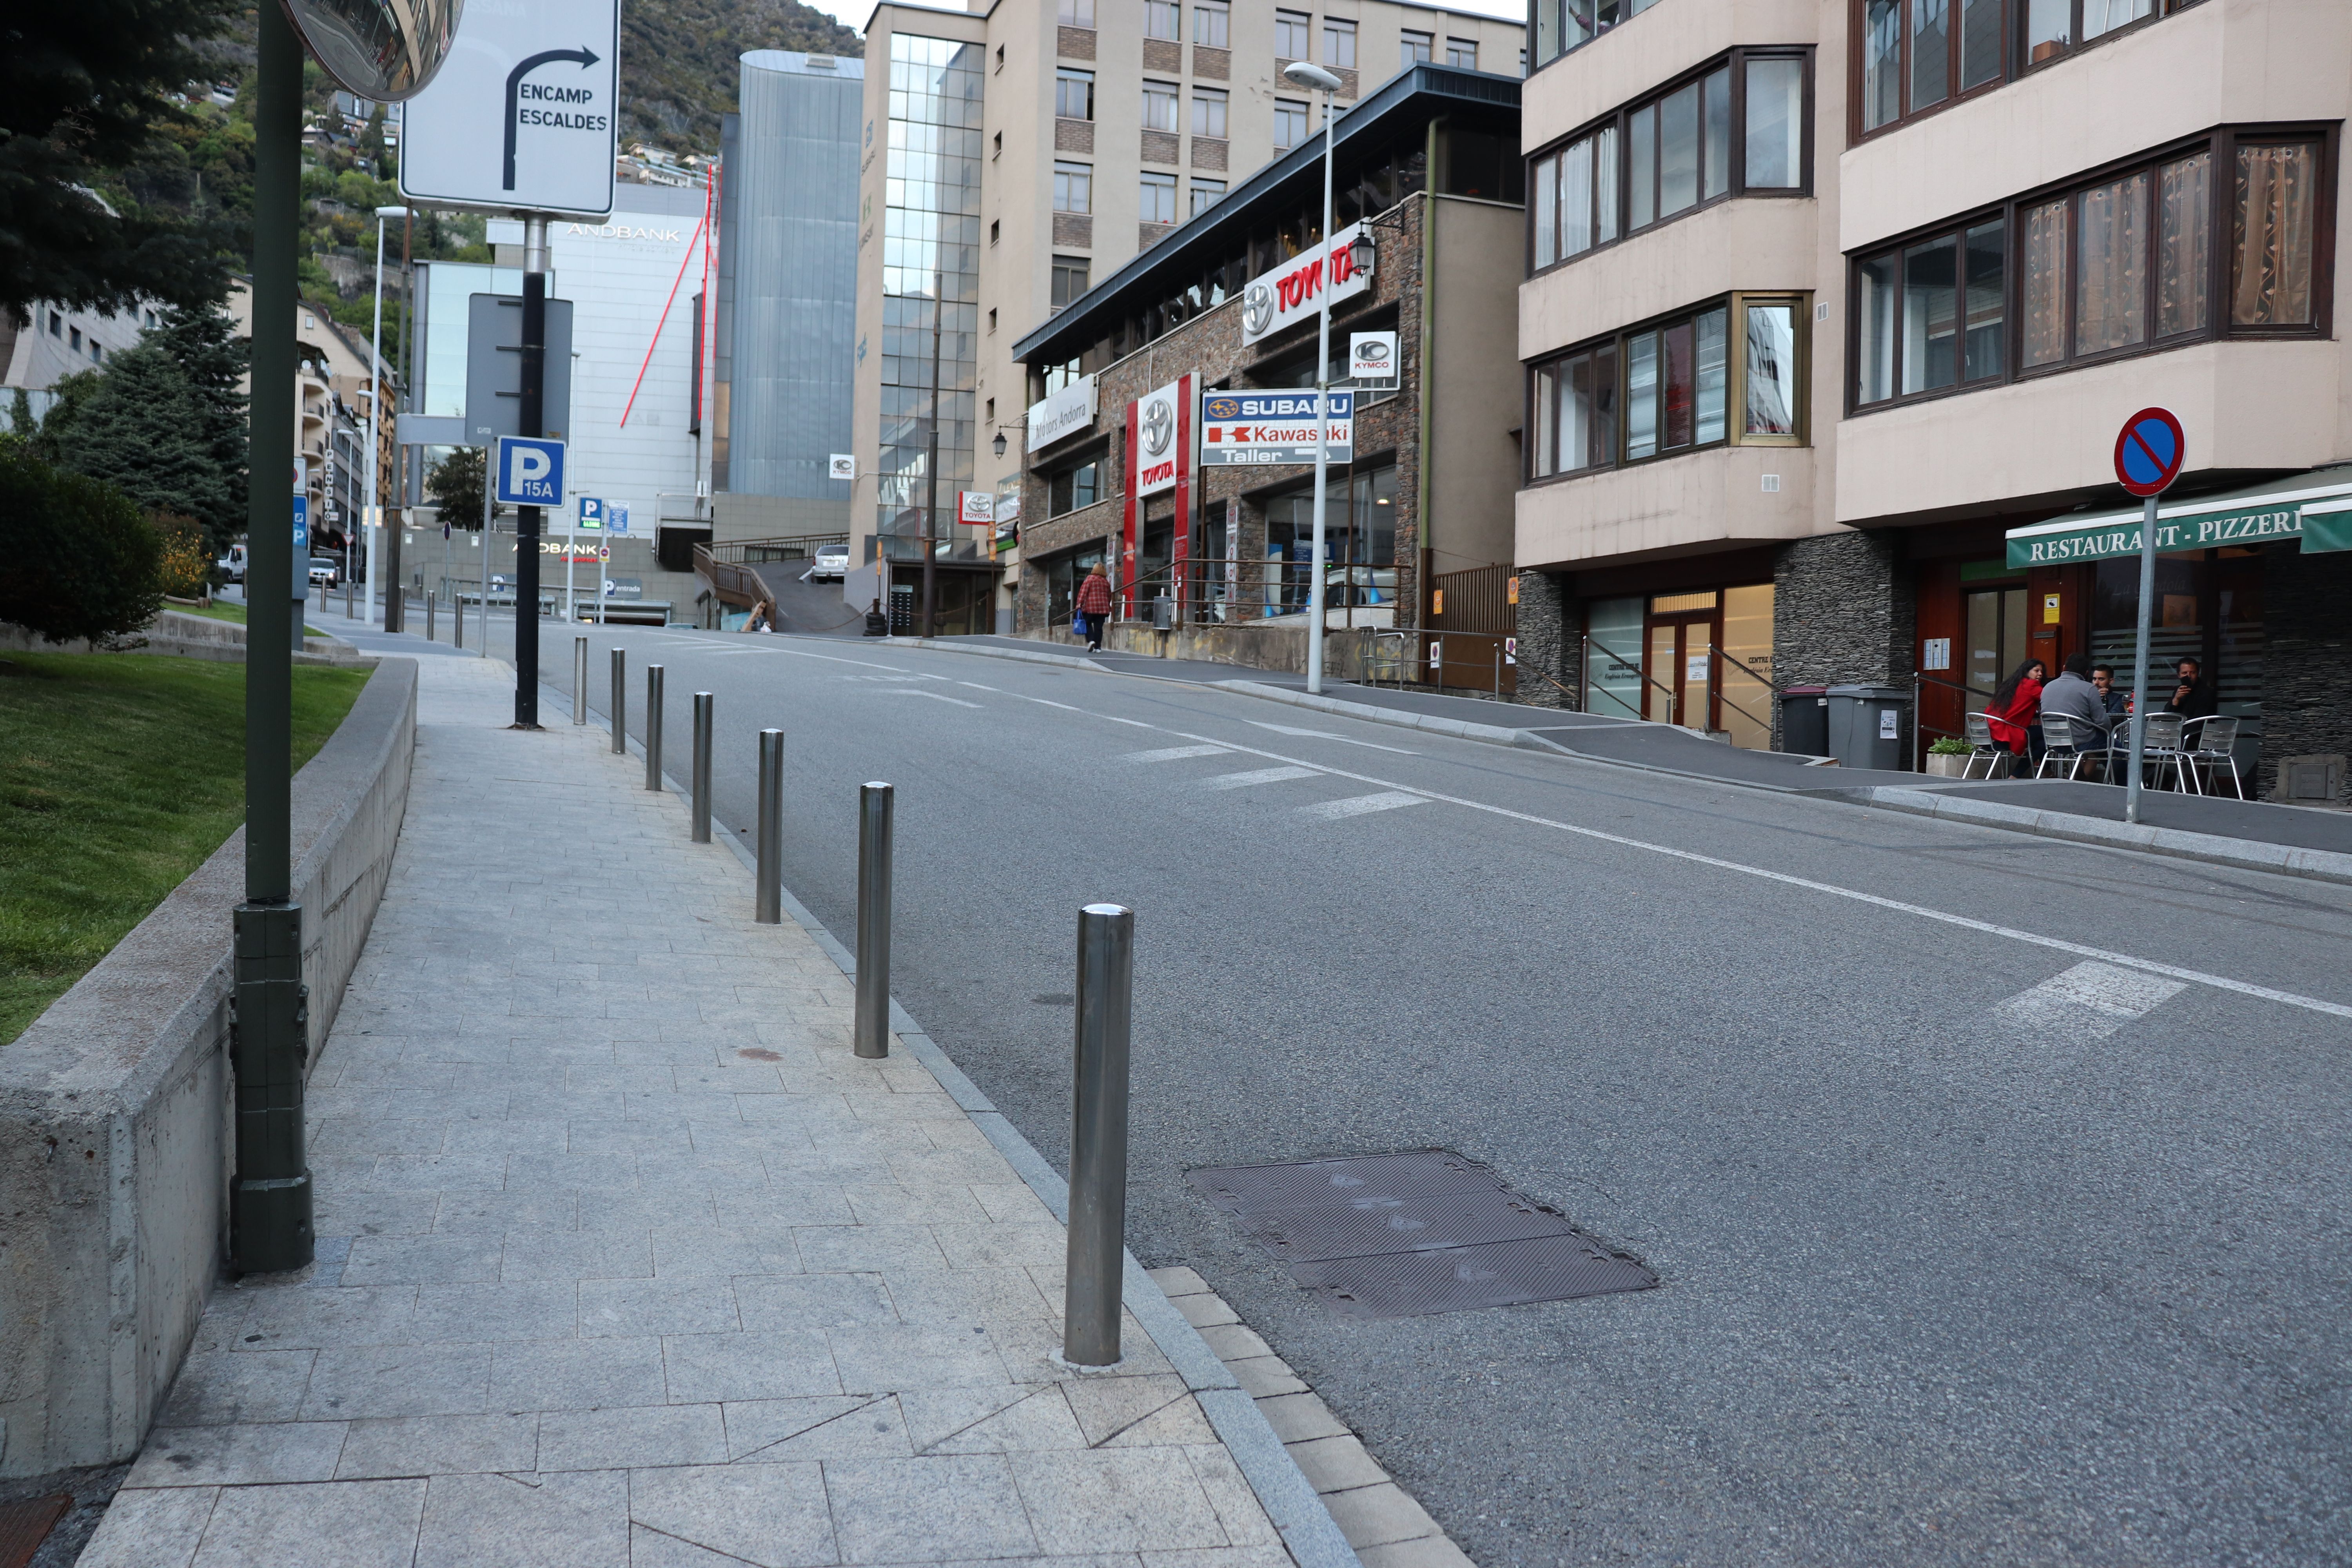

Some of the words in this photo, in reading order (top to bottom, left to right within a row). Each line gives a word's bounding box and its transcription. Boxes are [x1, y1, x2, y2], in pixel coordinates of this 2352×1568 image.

[521, 84, 592, 104] ENCAMP
[520, 109, 607, 130] ESCALDES
[567, 223, 679, 242] ANDBANK
[1036, 418, 1058, 439] Motors
[1059, 403, 1085, 429] Andorra
[1254, 425, 1347, 442] Kawaski
[1221, 449, 1282, 463] Taller
[510, 446, 551, 495] P
[1142, 459, 1174, 487] TOYOTA
[524, 481, 554, 497] 15A
[585, 500, 597, 516] P
[294, 529, 304, 542] P
[2197, 510, 2303, 543] PIZZERI
